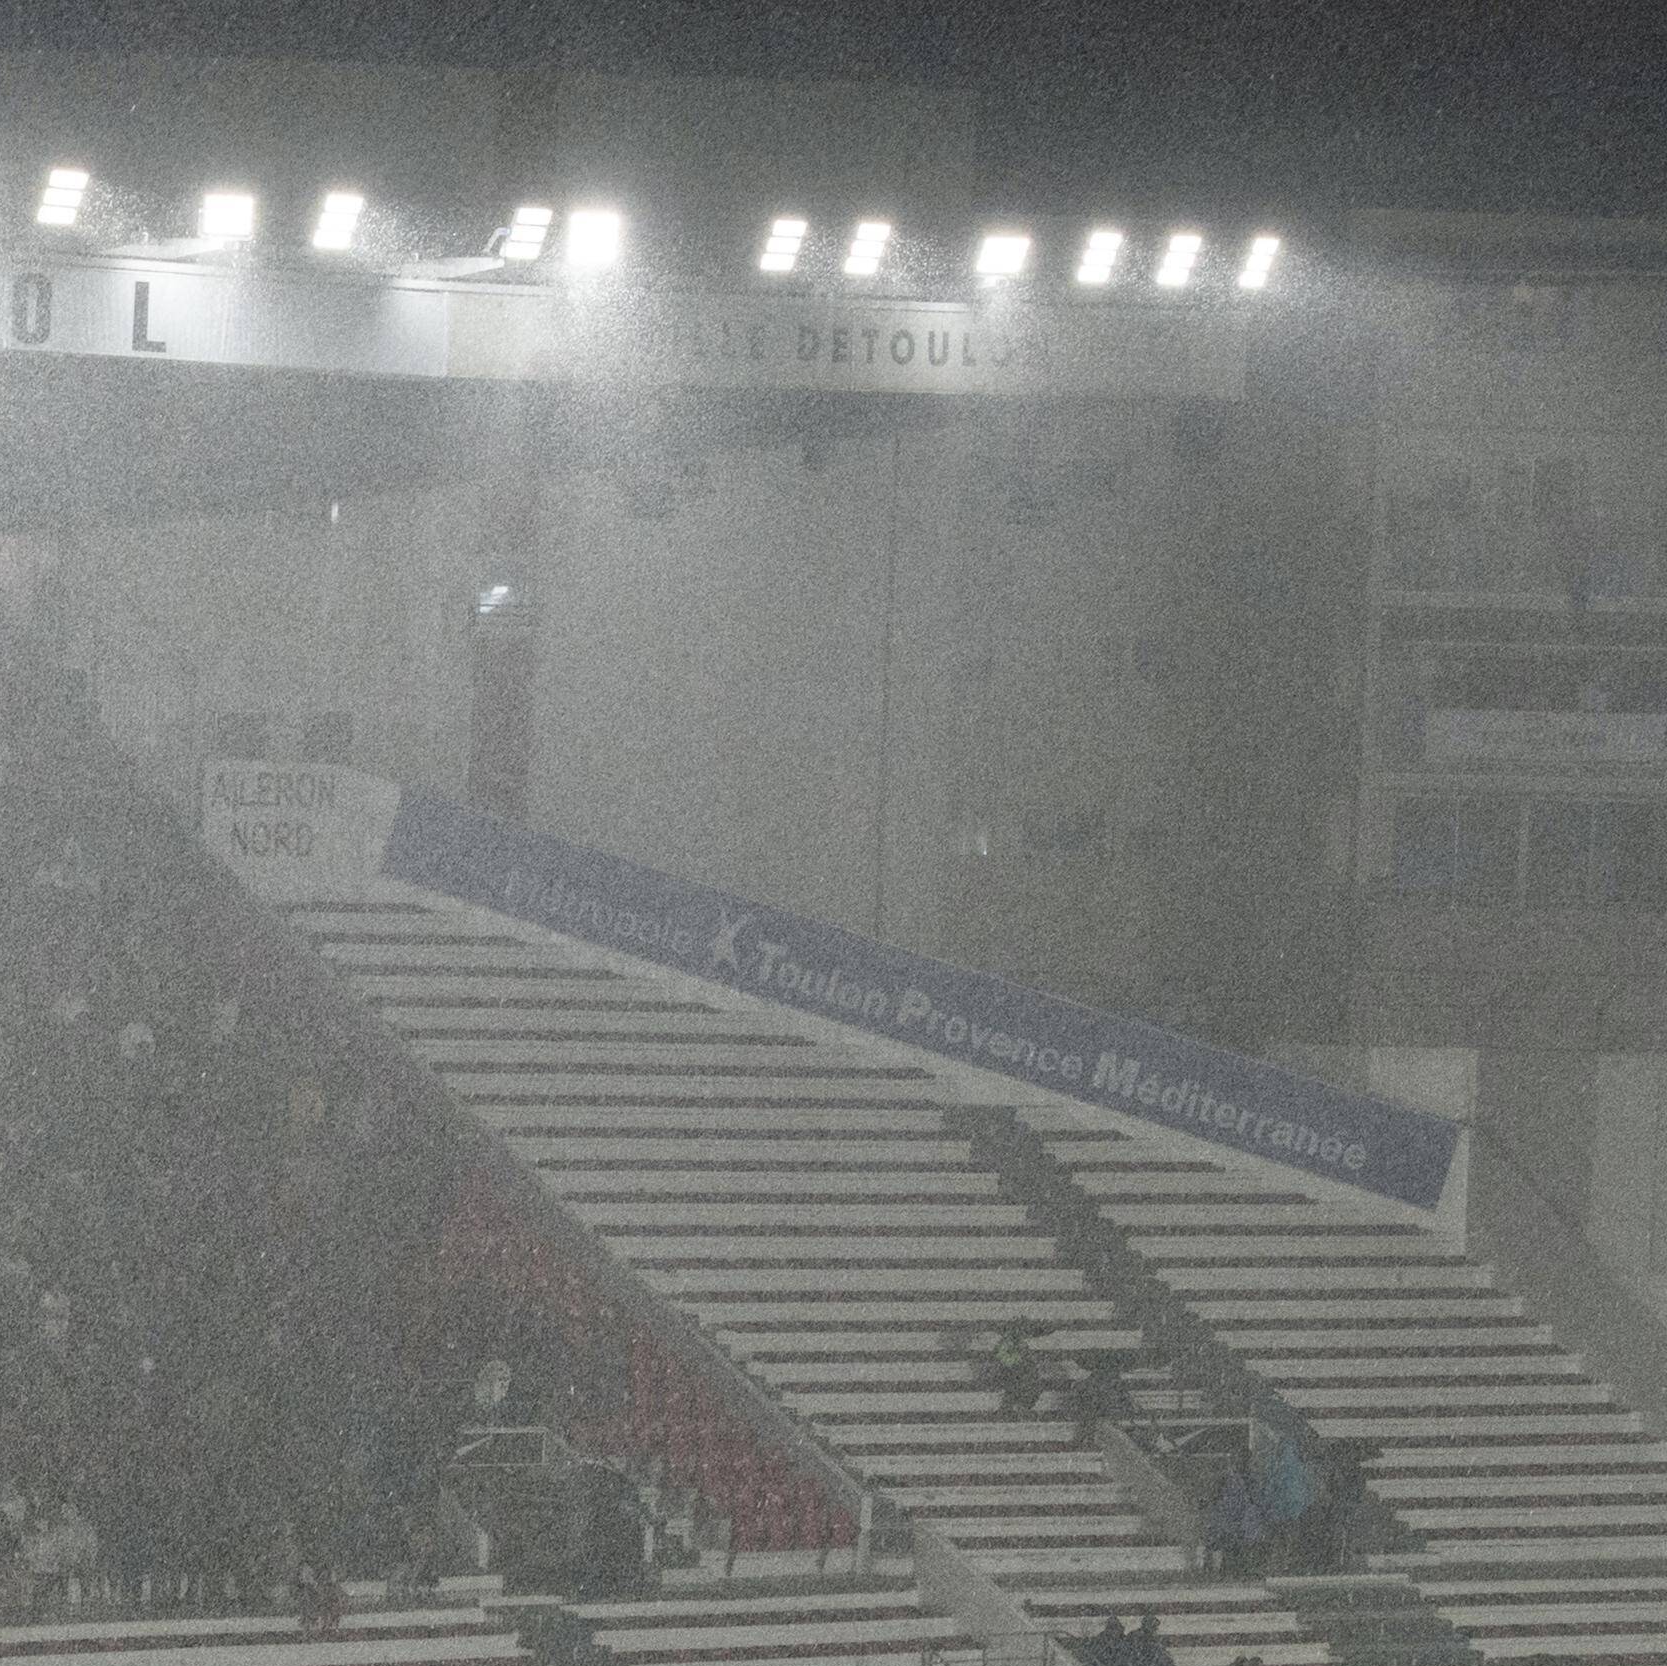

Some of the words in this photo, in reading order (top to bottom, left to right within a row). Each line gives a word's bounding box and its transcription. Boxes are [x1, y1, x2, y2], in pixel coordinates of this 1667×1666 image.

[210, 771, 337, 811] AILERON
[231, 820, 316, 858] NORD
[757, 939, 886, 1021] Toulon
[897, 992, 1083, 1082] Provence
